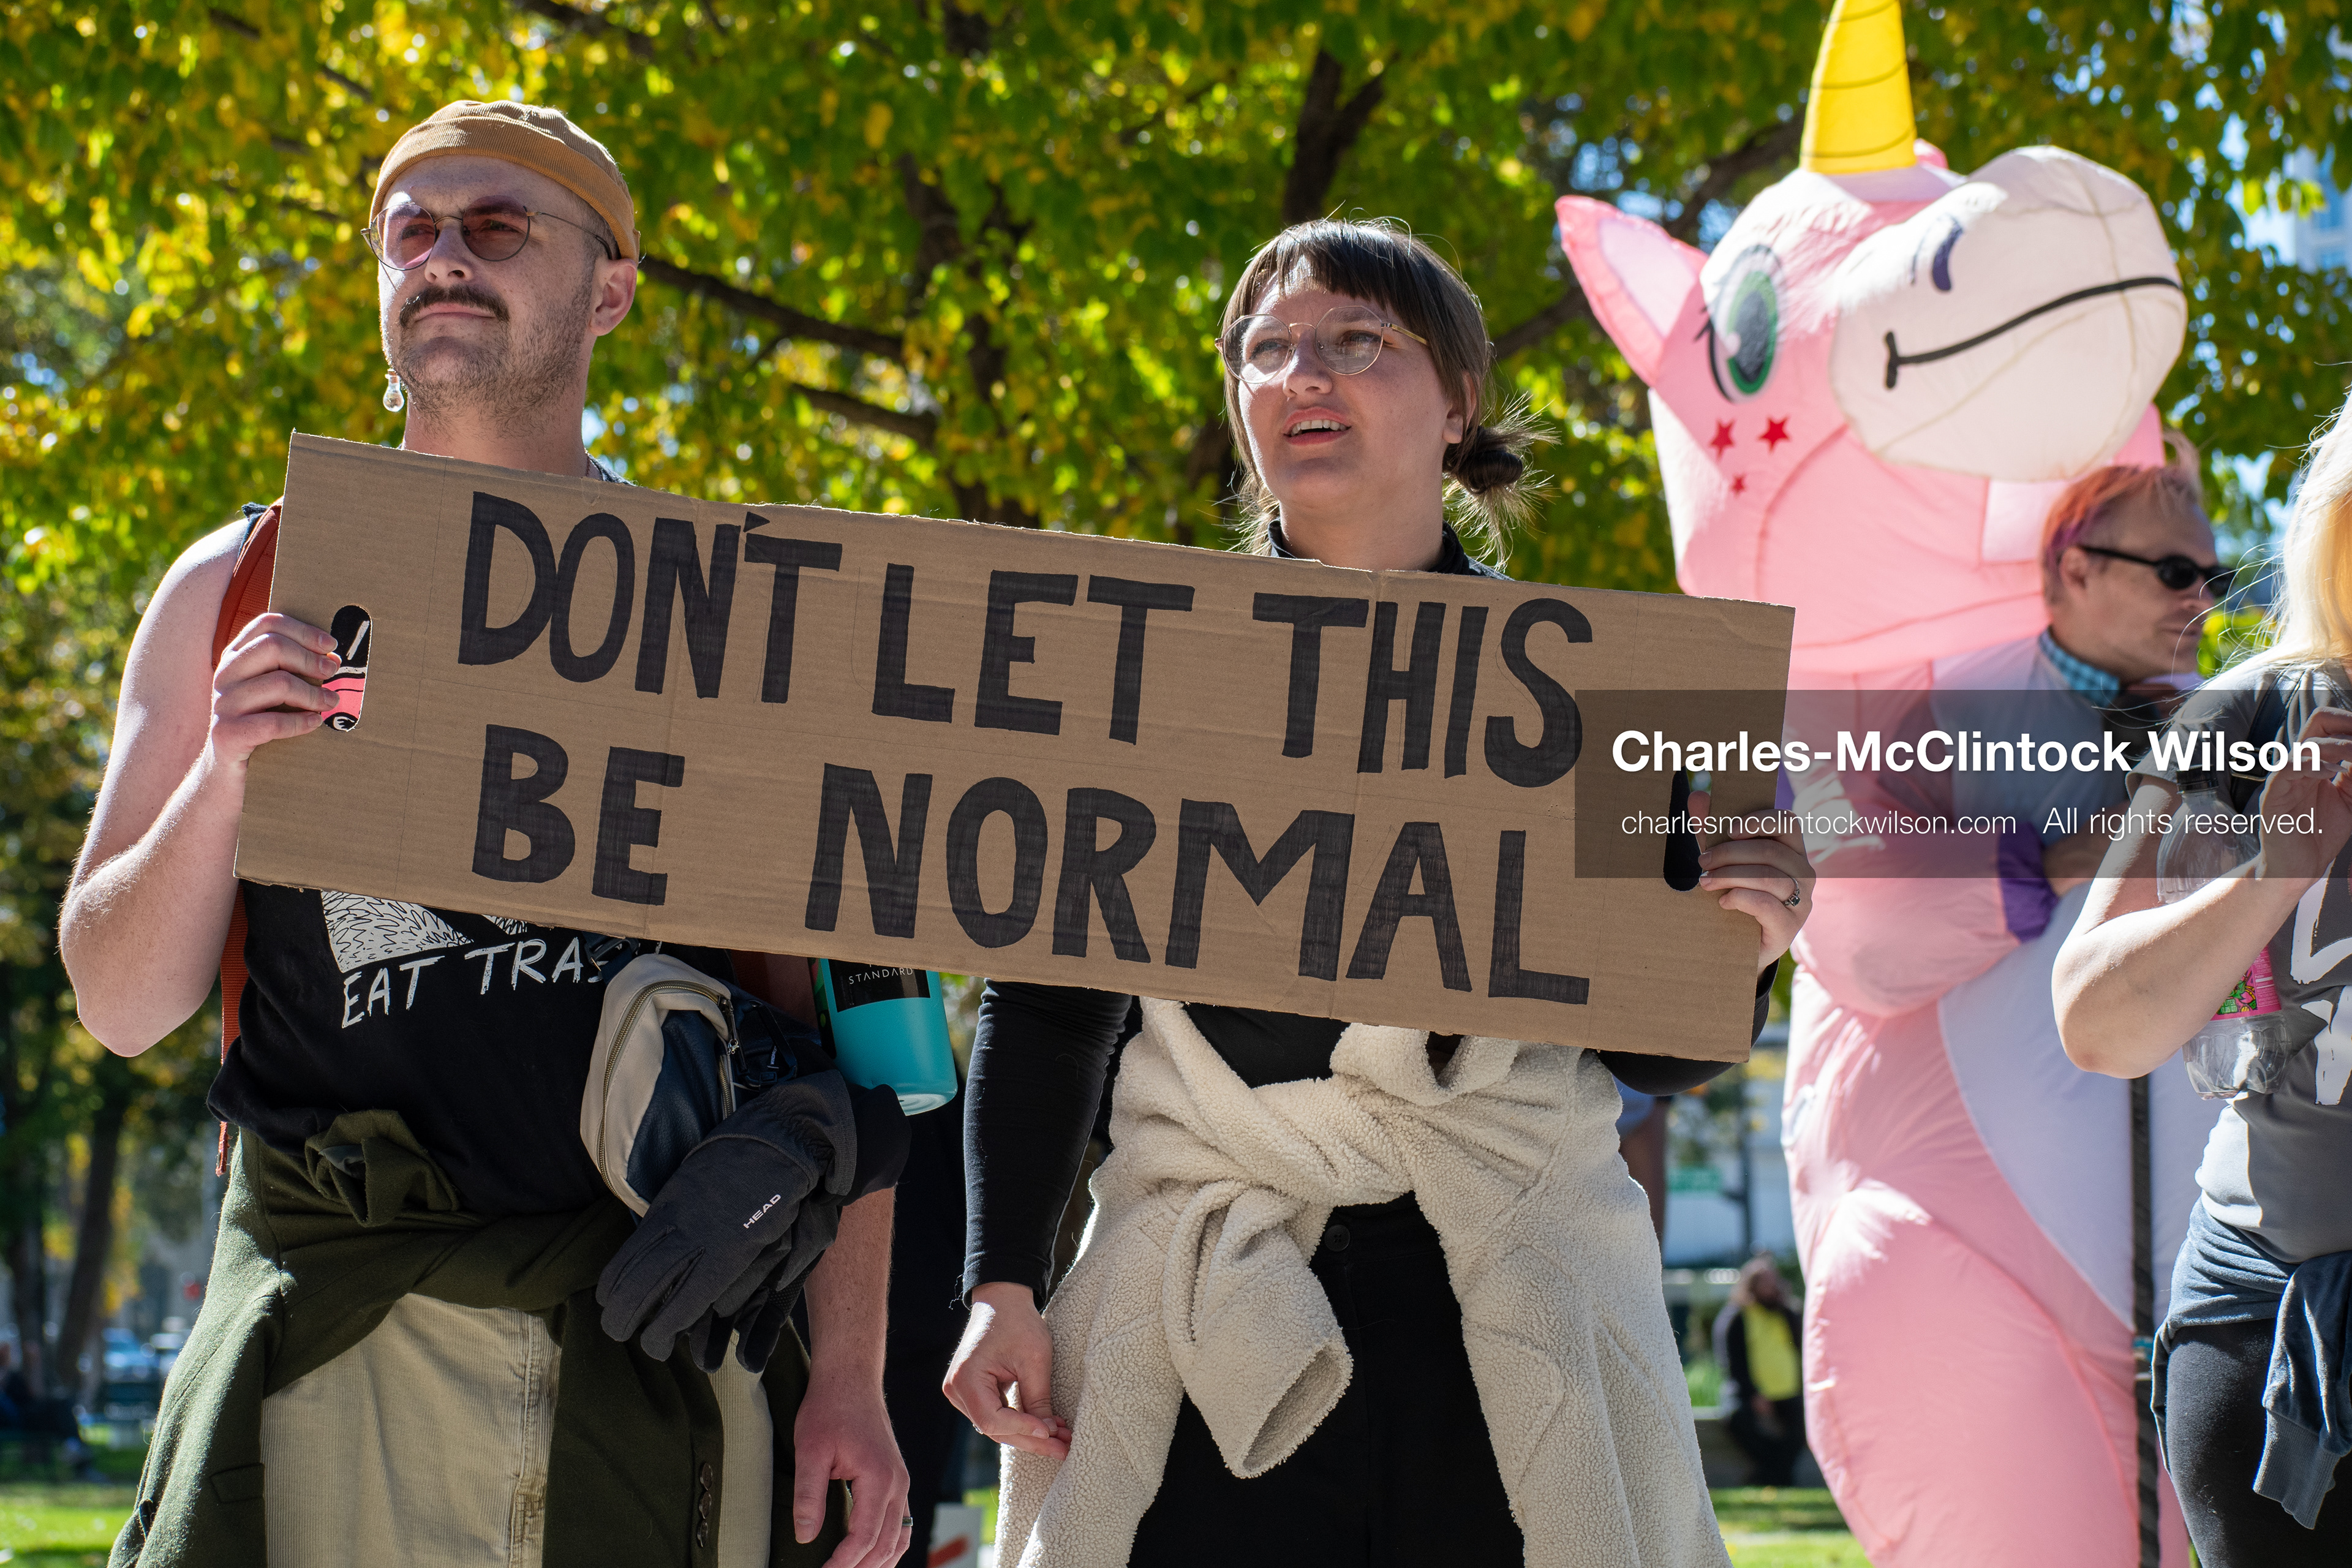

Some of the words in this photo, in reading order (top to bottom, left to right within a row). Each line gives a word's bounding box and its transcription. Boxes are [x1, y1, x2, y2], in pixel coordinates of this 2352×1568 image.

[458, 491, 843, 704] DON'T
[870, 562, 1196, 746] LET
[1252, 592, 1593, 789] THIS
[471, 723, 685, 907] BE
[804, 762, 1590, 1006] NORMAL
[341, 956, 445, 1029] EAT
[464, 937, 663, 995] TRA
[848, 967, 913, 985] STANDARD
[743, 1194, 782, 1229] HEAD
